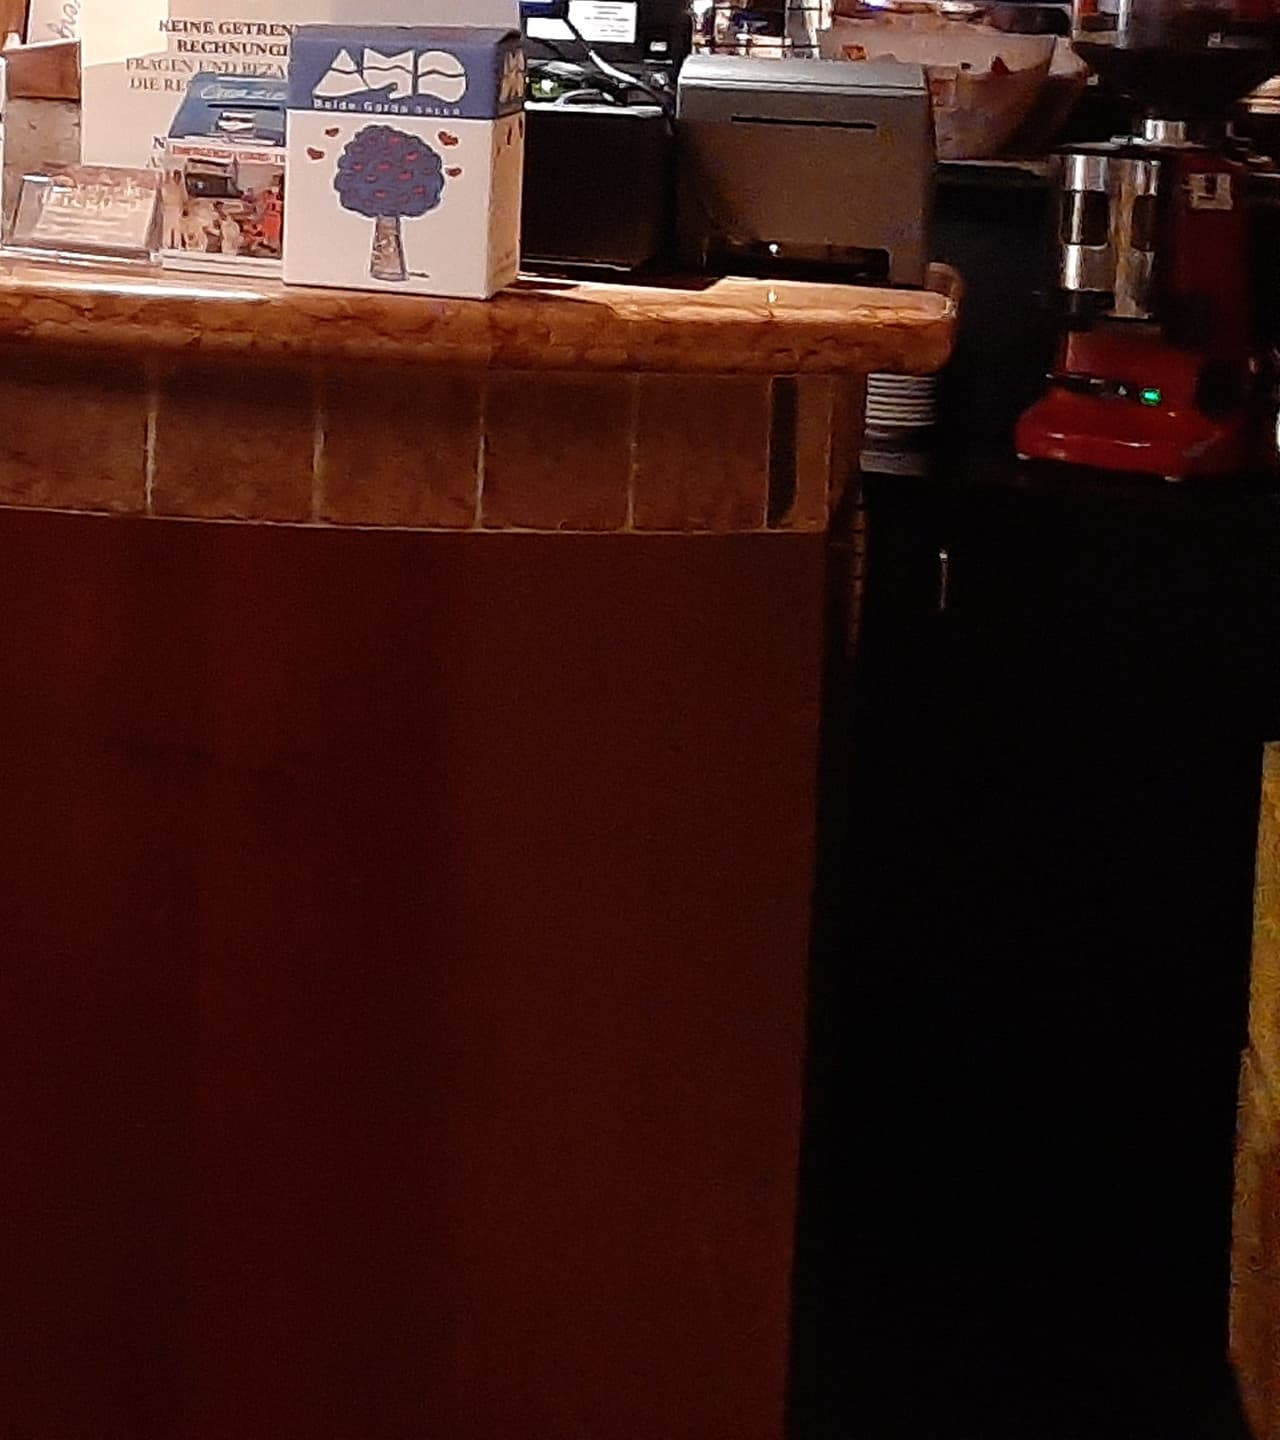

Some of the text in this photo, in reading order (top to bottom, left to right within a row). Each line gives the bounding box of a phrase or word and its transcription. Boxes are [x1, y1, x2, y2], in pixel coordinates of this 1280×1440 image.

[160, 20, 292, 37] KEINE GETREN
[177, 39, 289, 57] RECHNUNG
[126, 58, 193, 73] FRAGEN
[130, 78, 160, 91] DIE
